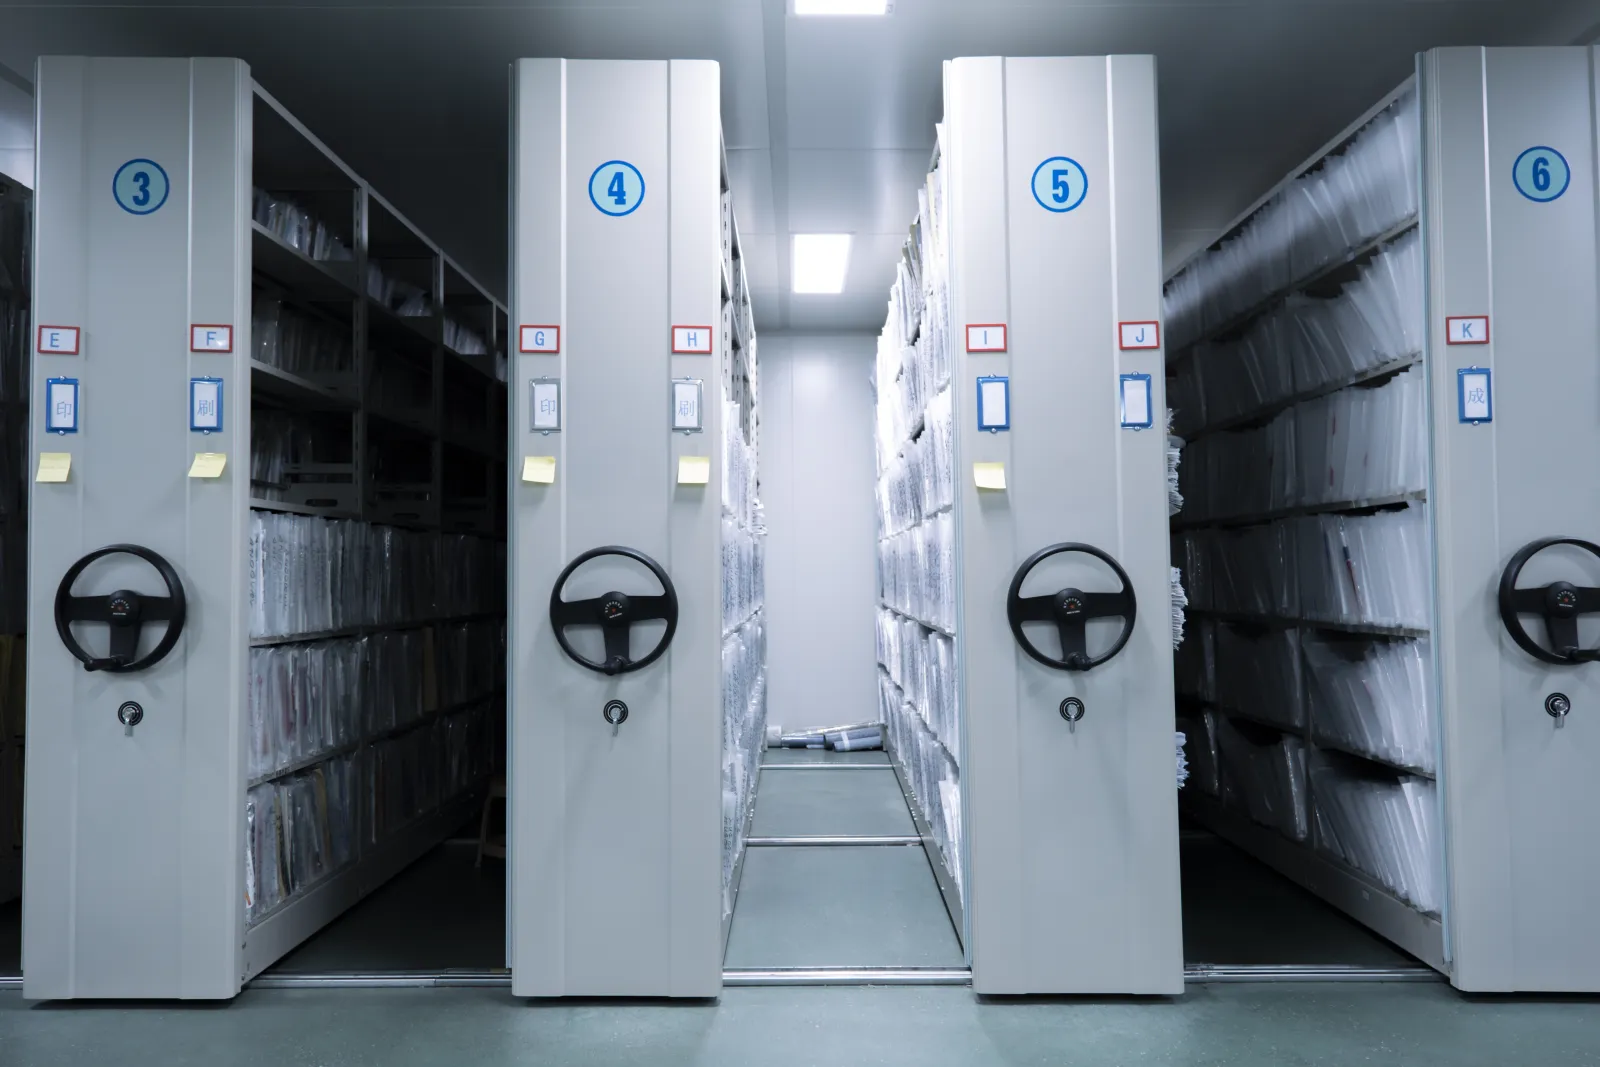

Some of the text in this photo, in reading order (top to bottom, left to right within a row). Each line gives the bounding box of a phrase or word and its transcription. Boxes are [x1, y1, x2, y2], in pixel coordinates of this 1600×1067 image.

[1532, 157, 1551, 191] 6
[132, 171, 150, 206] 3
[608, 172, 626, 205] 4
[1052, 169, 1070, 203] 5
[206, 331, 217, 346] F
[534, 330, 545, 347] G
[687, 331, 698, 347] H
[983, 330, 988, 345] I
[1135, 327, 1145, 343] J
[1462, 322, 1473, 339] K
[50, 332, 60, 348] E
[1467, 387, 1486, 405] 成
[56, 401, 73, 419] 印
[197, 399, 214, 417] 刷
[540, 398, 556, 416] 印
[677, 399, 695, 417] 刷
